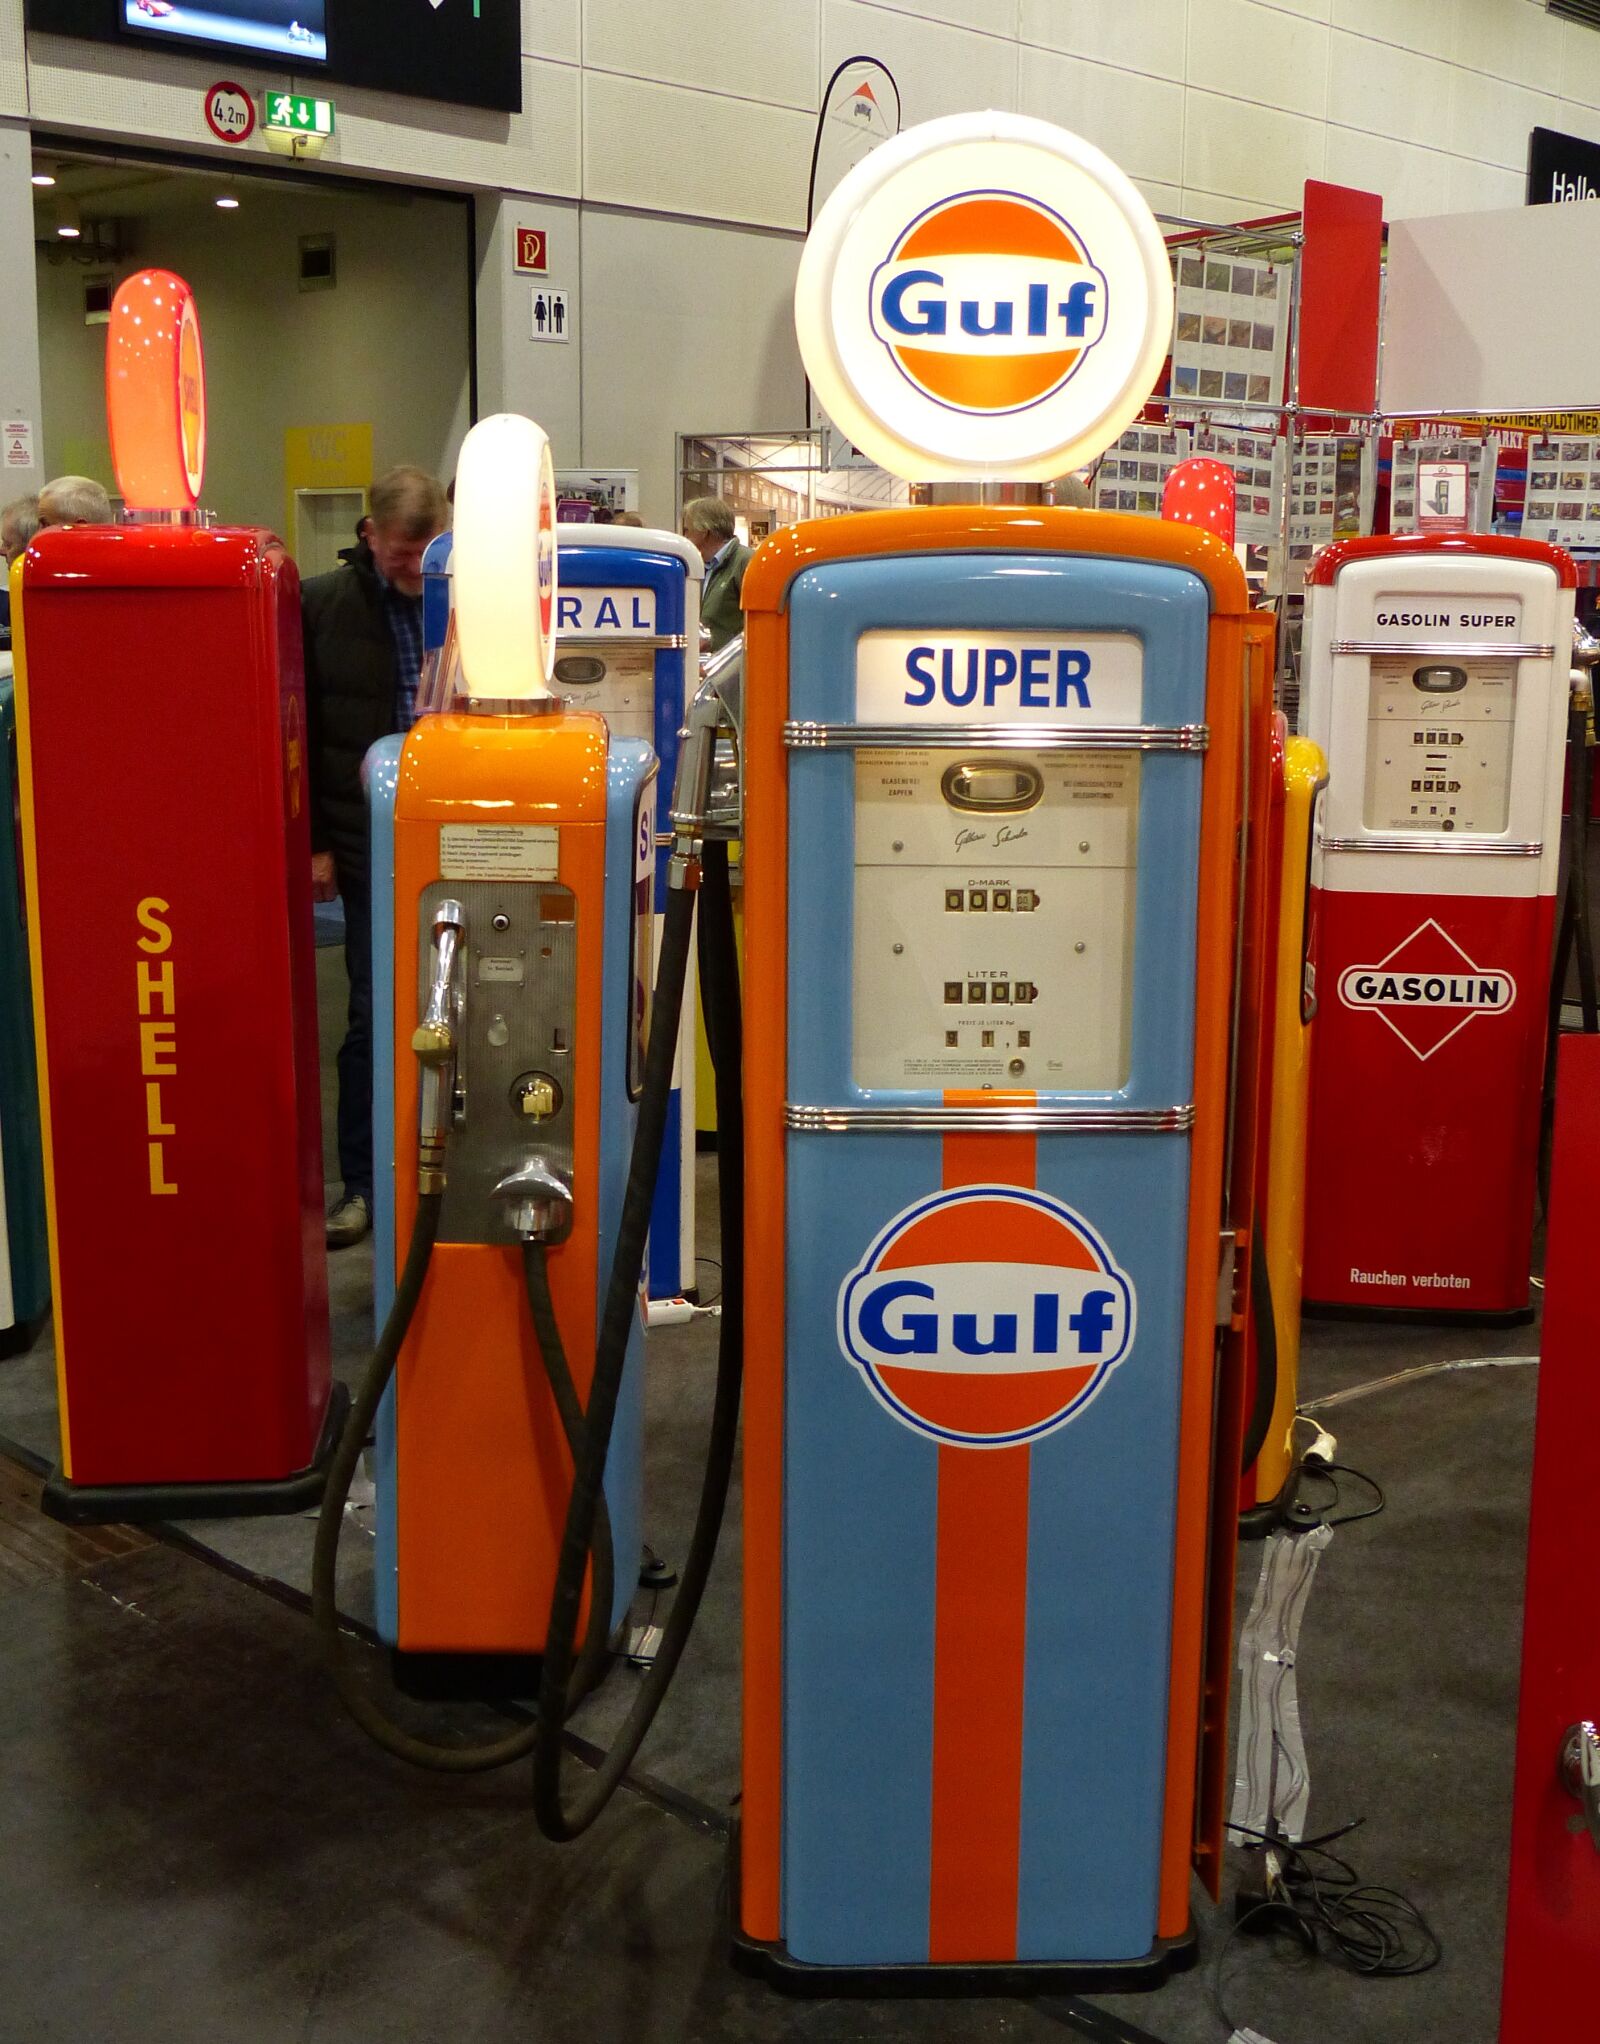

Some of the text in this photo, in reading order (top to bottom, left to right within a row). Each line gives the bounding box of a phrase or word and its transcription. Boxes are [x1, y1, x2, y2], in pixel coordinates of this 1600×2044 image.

[213, 98, 246, 125] 4.2m
[881, 269, 1096, 337] Gulf
[1418, 421, 1463, 440] MARKT
[557, 596, 651, 629] RAL
[1376, 613, 1516, 628] GASOLIN SUPER
[904, 646, 1091, 709] SUPER
[1355, 976, 1499, 1004] GASOLIN
[136, 896, 178, 1195] SHELL
[1350, 1267, 1470, 1289] Rauchen verboten
[858, 1279, 1116, 1356] Gulf
